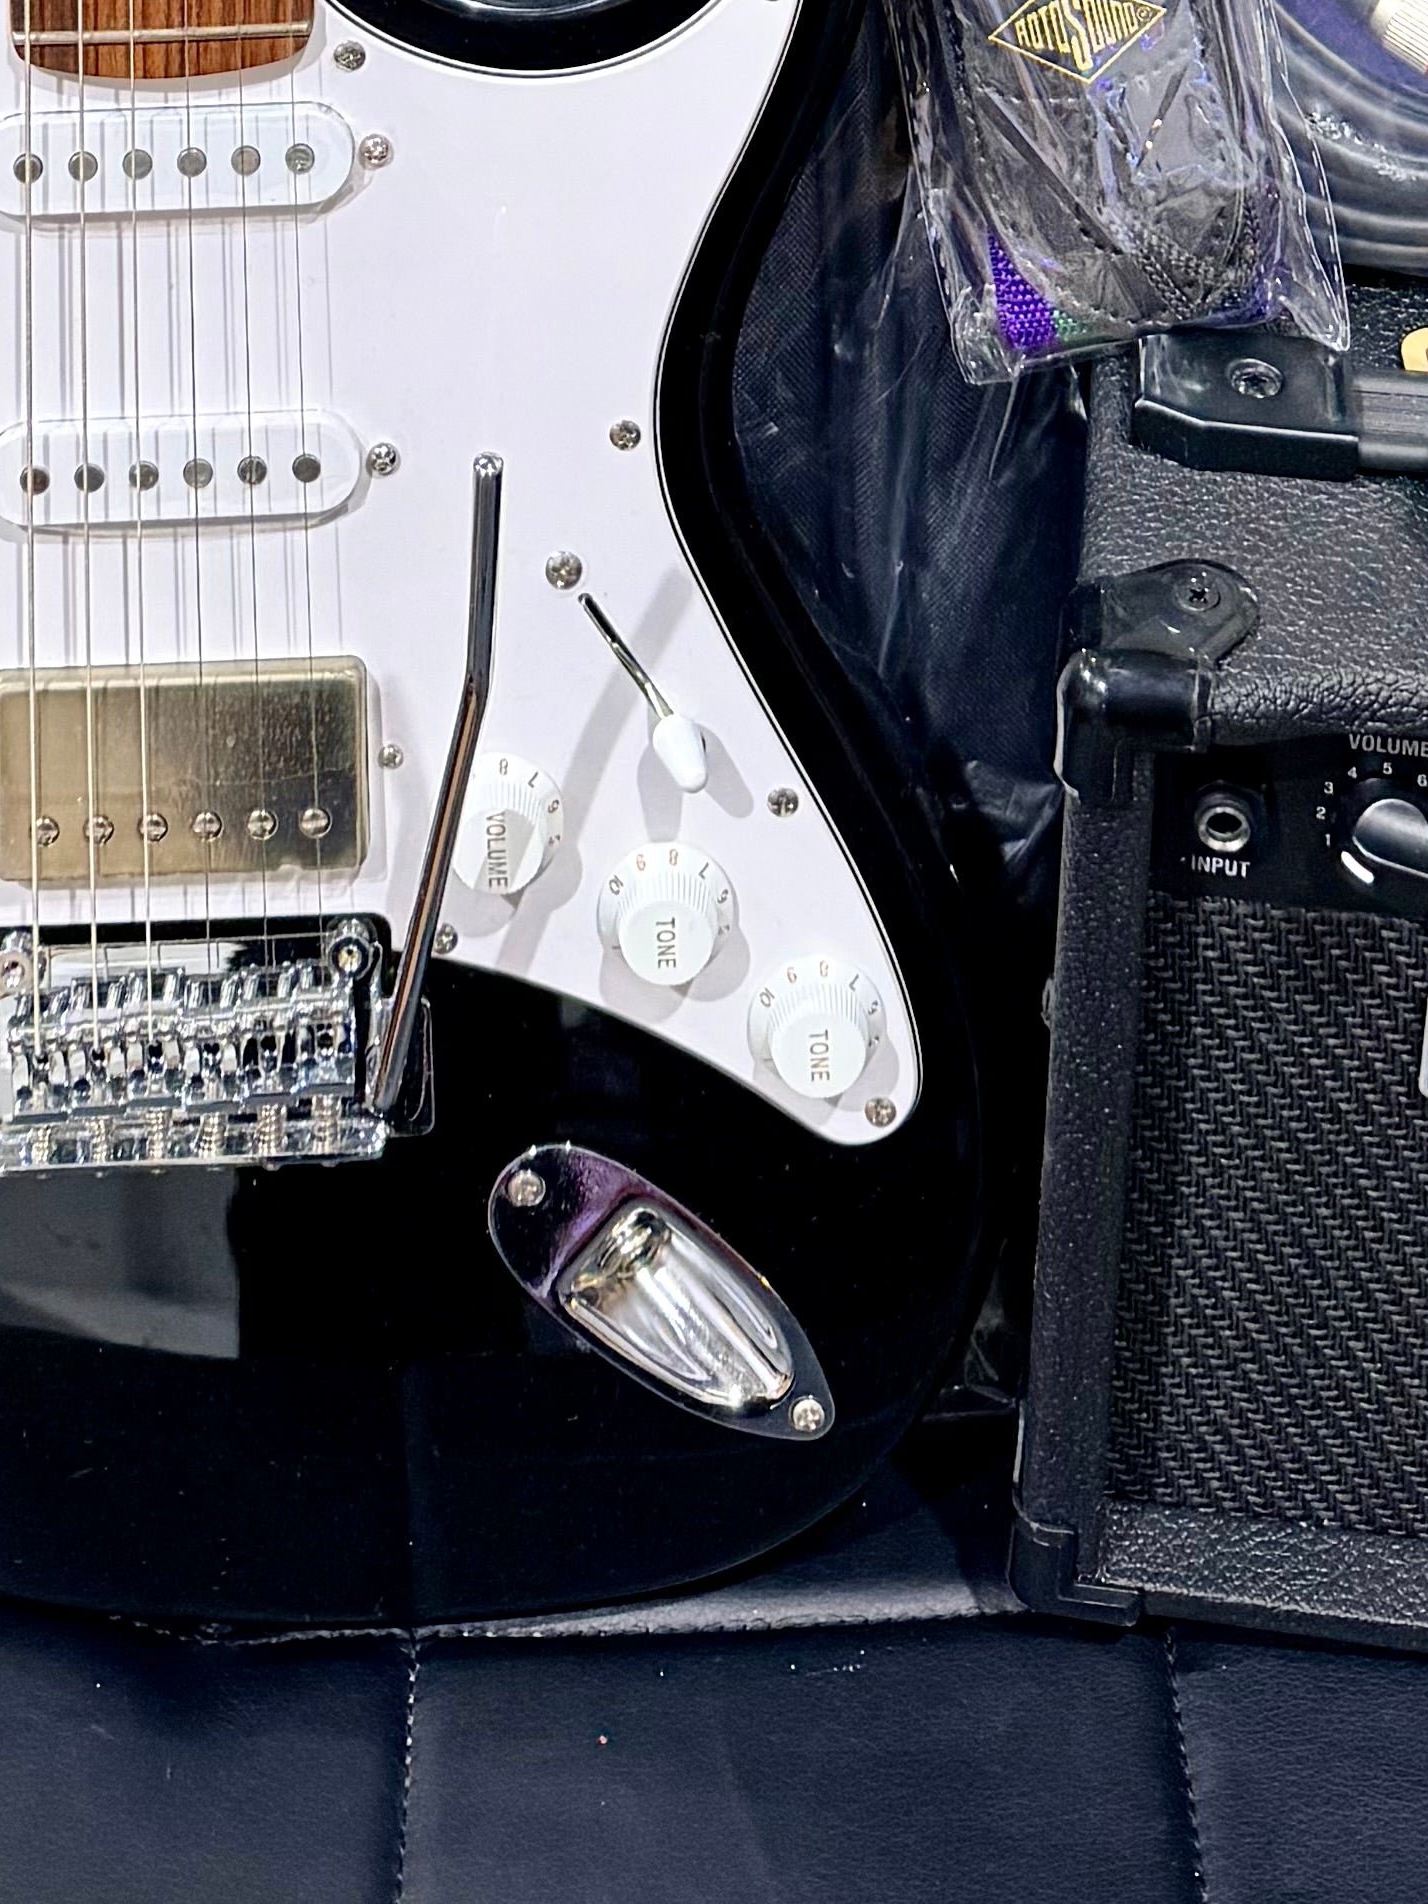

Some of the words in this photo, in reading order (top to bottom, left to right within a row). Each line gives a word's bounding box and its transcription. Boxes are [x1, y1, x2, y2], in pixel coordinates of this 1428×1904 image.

[1316, 805, 1327, 821] 2
[1323, 781, 1335, 796] 3
[1347, 765, 1359, 780] 4
[1383, 762, 1394, 776] 5
[1417, 773, 1428, 788] 6
[485, 811, 510, 890] VOLUME
[1190, 853, 1251, 879] INPUT
[655, 916, 677, 970] TONE
[808, 1028, 832, 1083] TONE
